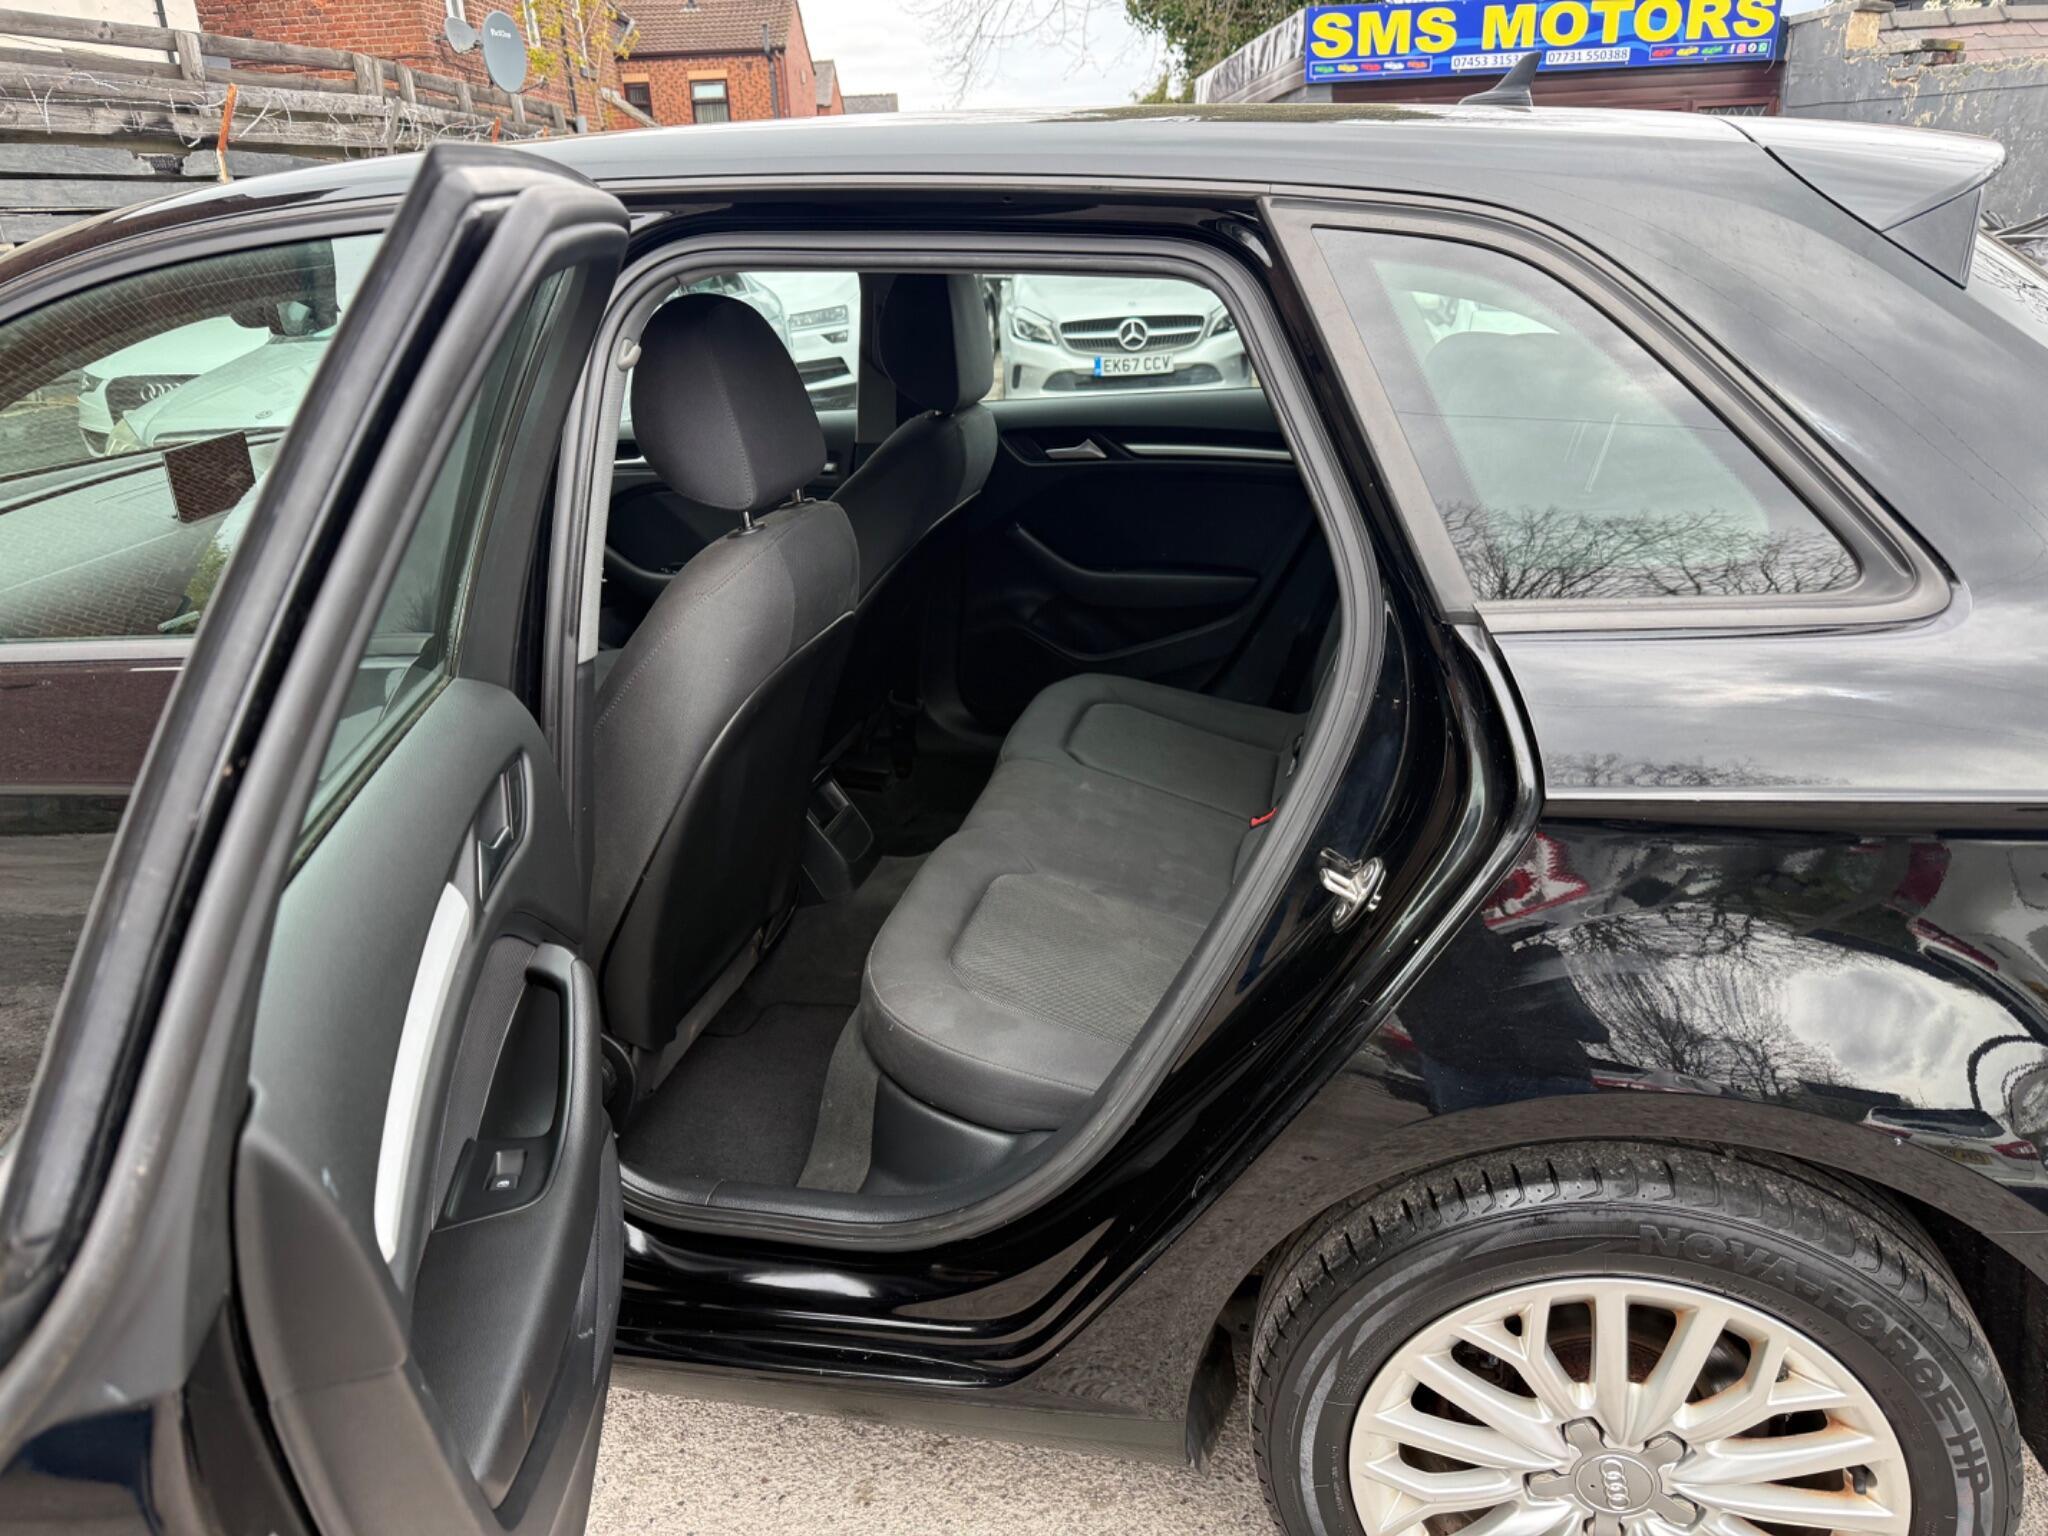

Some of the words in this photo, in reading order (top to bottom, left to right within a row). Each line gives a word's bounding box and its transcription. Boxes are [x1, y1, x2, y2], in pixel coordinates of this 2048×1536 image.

[1311, 7, 1457, 58] SMS
[1482, 0, 1776, 50] MOTORS
[1453, 56, 1488, 67] 07453
[1548, 51, 1582, 63] 07731
[1586, 48, 1628, 61] 550388
[1103, 357, 1140, 373] EK67
[1143, 355, 1171, 371] CCV
